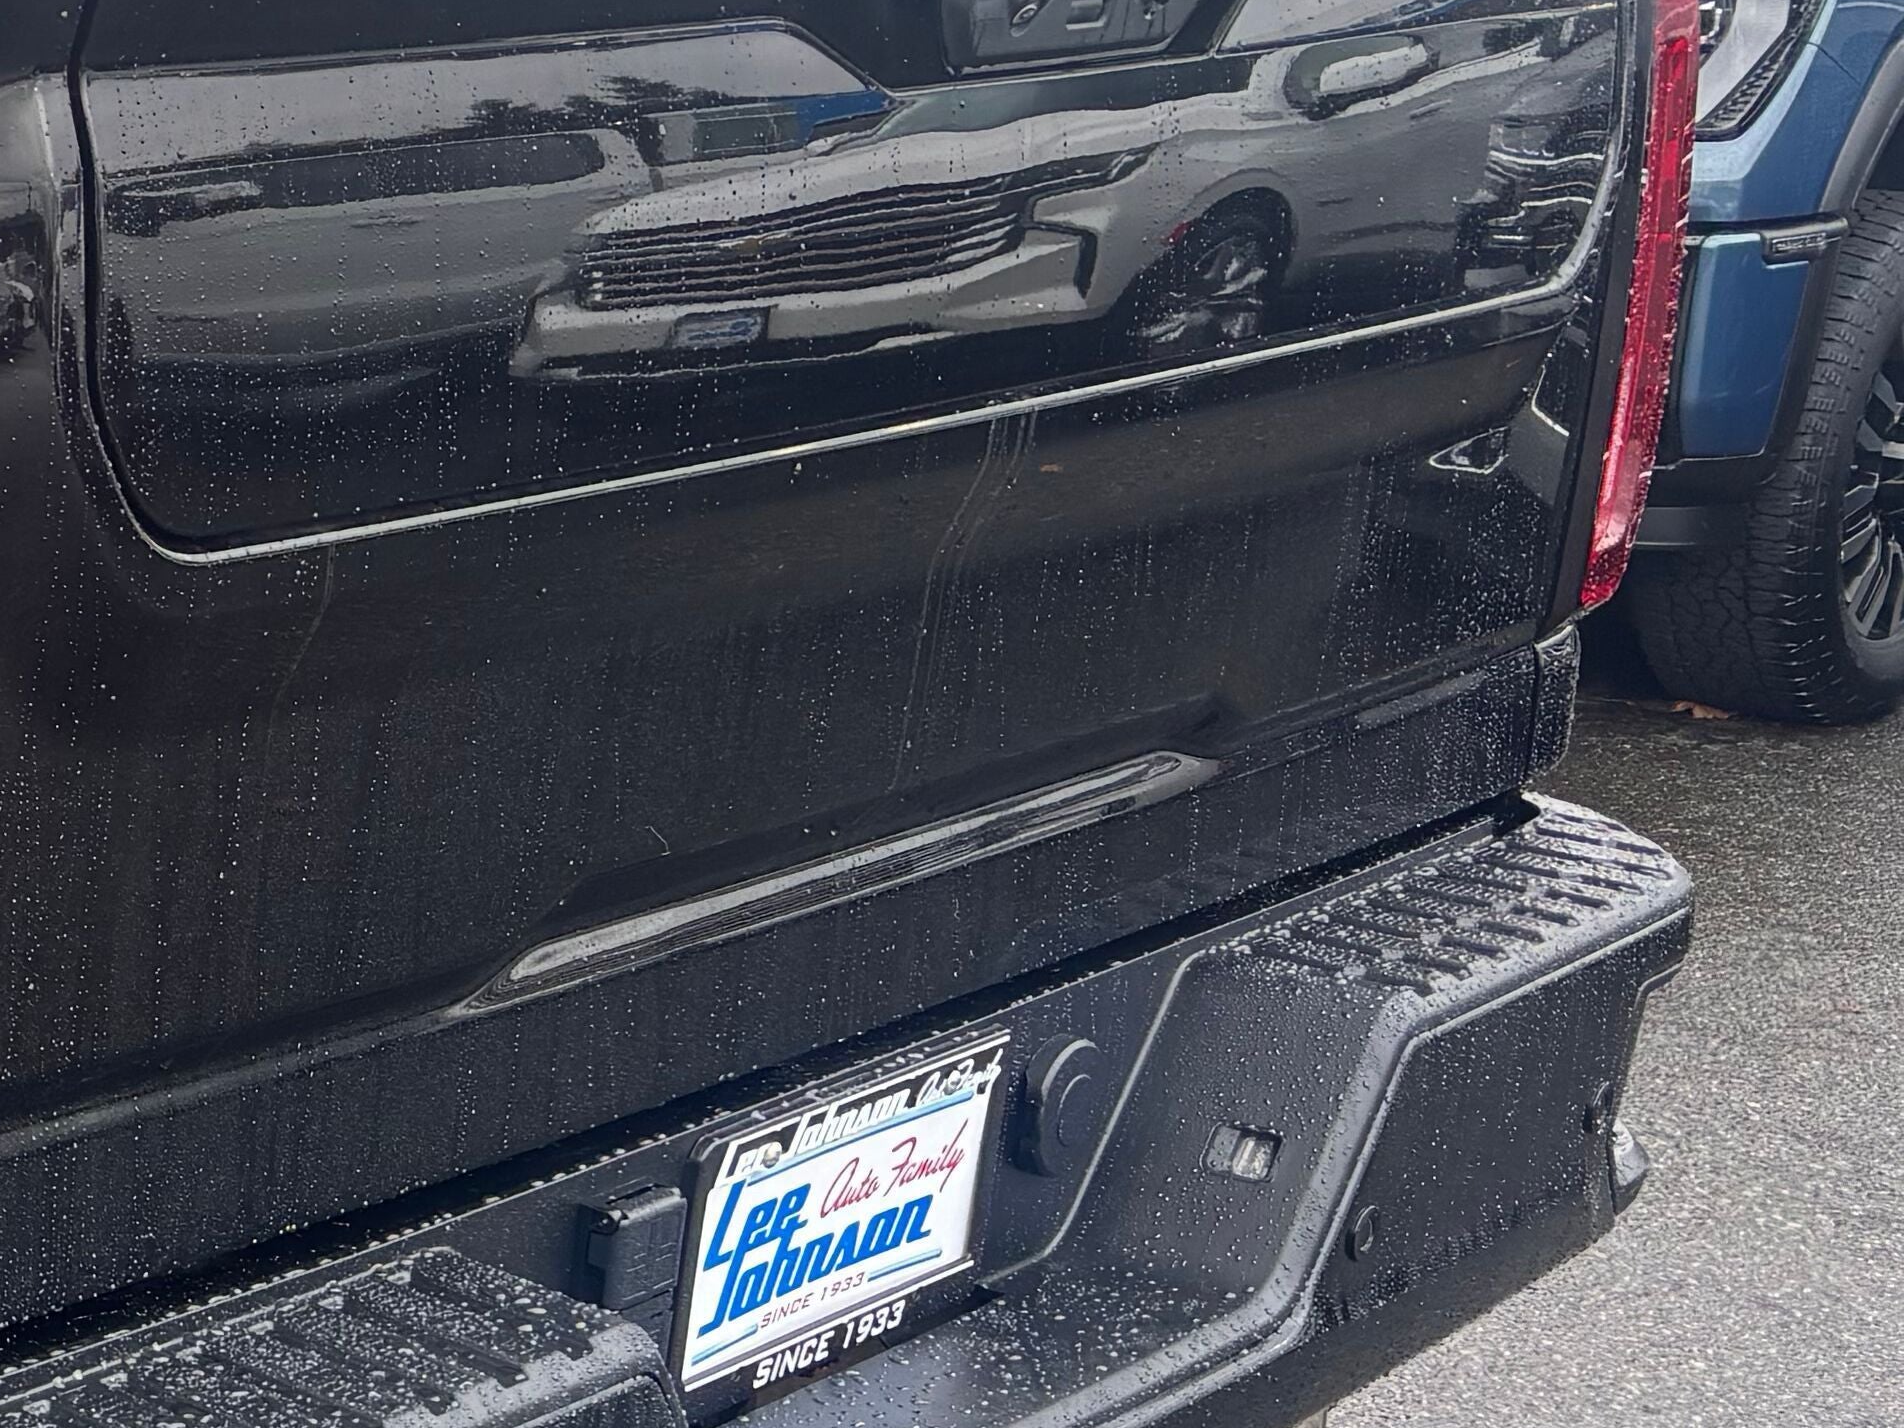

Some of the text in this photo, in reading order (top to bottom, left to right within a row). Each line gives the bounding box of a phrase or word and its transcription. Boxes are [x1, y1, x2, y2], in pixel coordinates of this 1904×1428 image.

[782, 1088, 911, 1160] Johnson
[820, 1117, 969, 1219] Auto Family
[697, 1194, 933, 1339] Johnson
[703, 1179, 811, 1273] Lee
[752, 1299, 907, 1390] SINCE 1933
[760, 1271, 866, 1329] SINCE 1933
